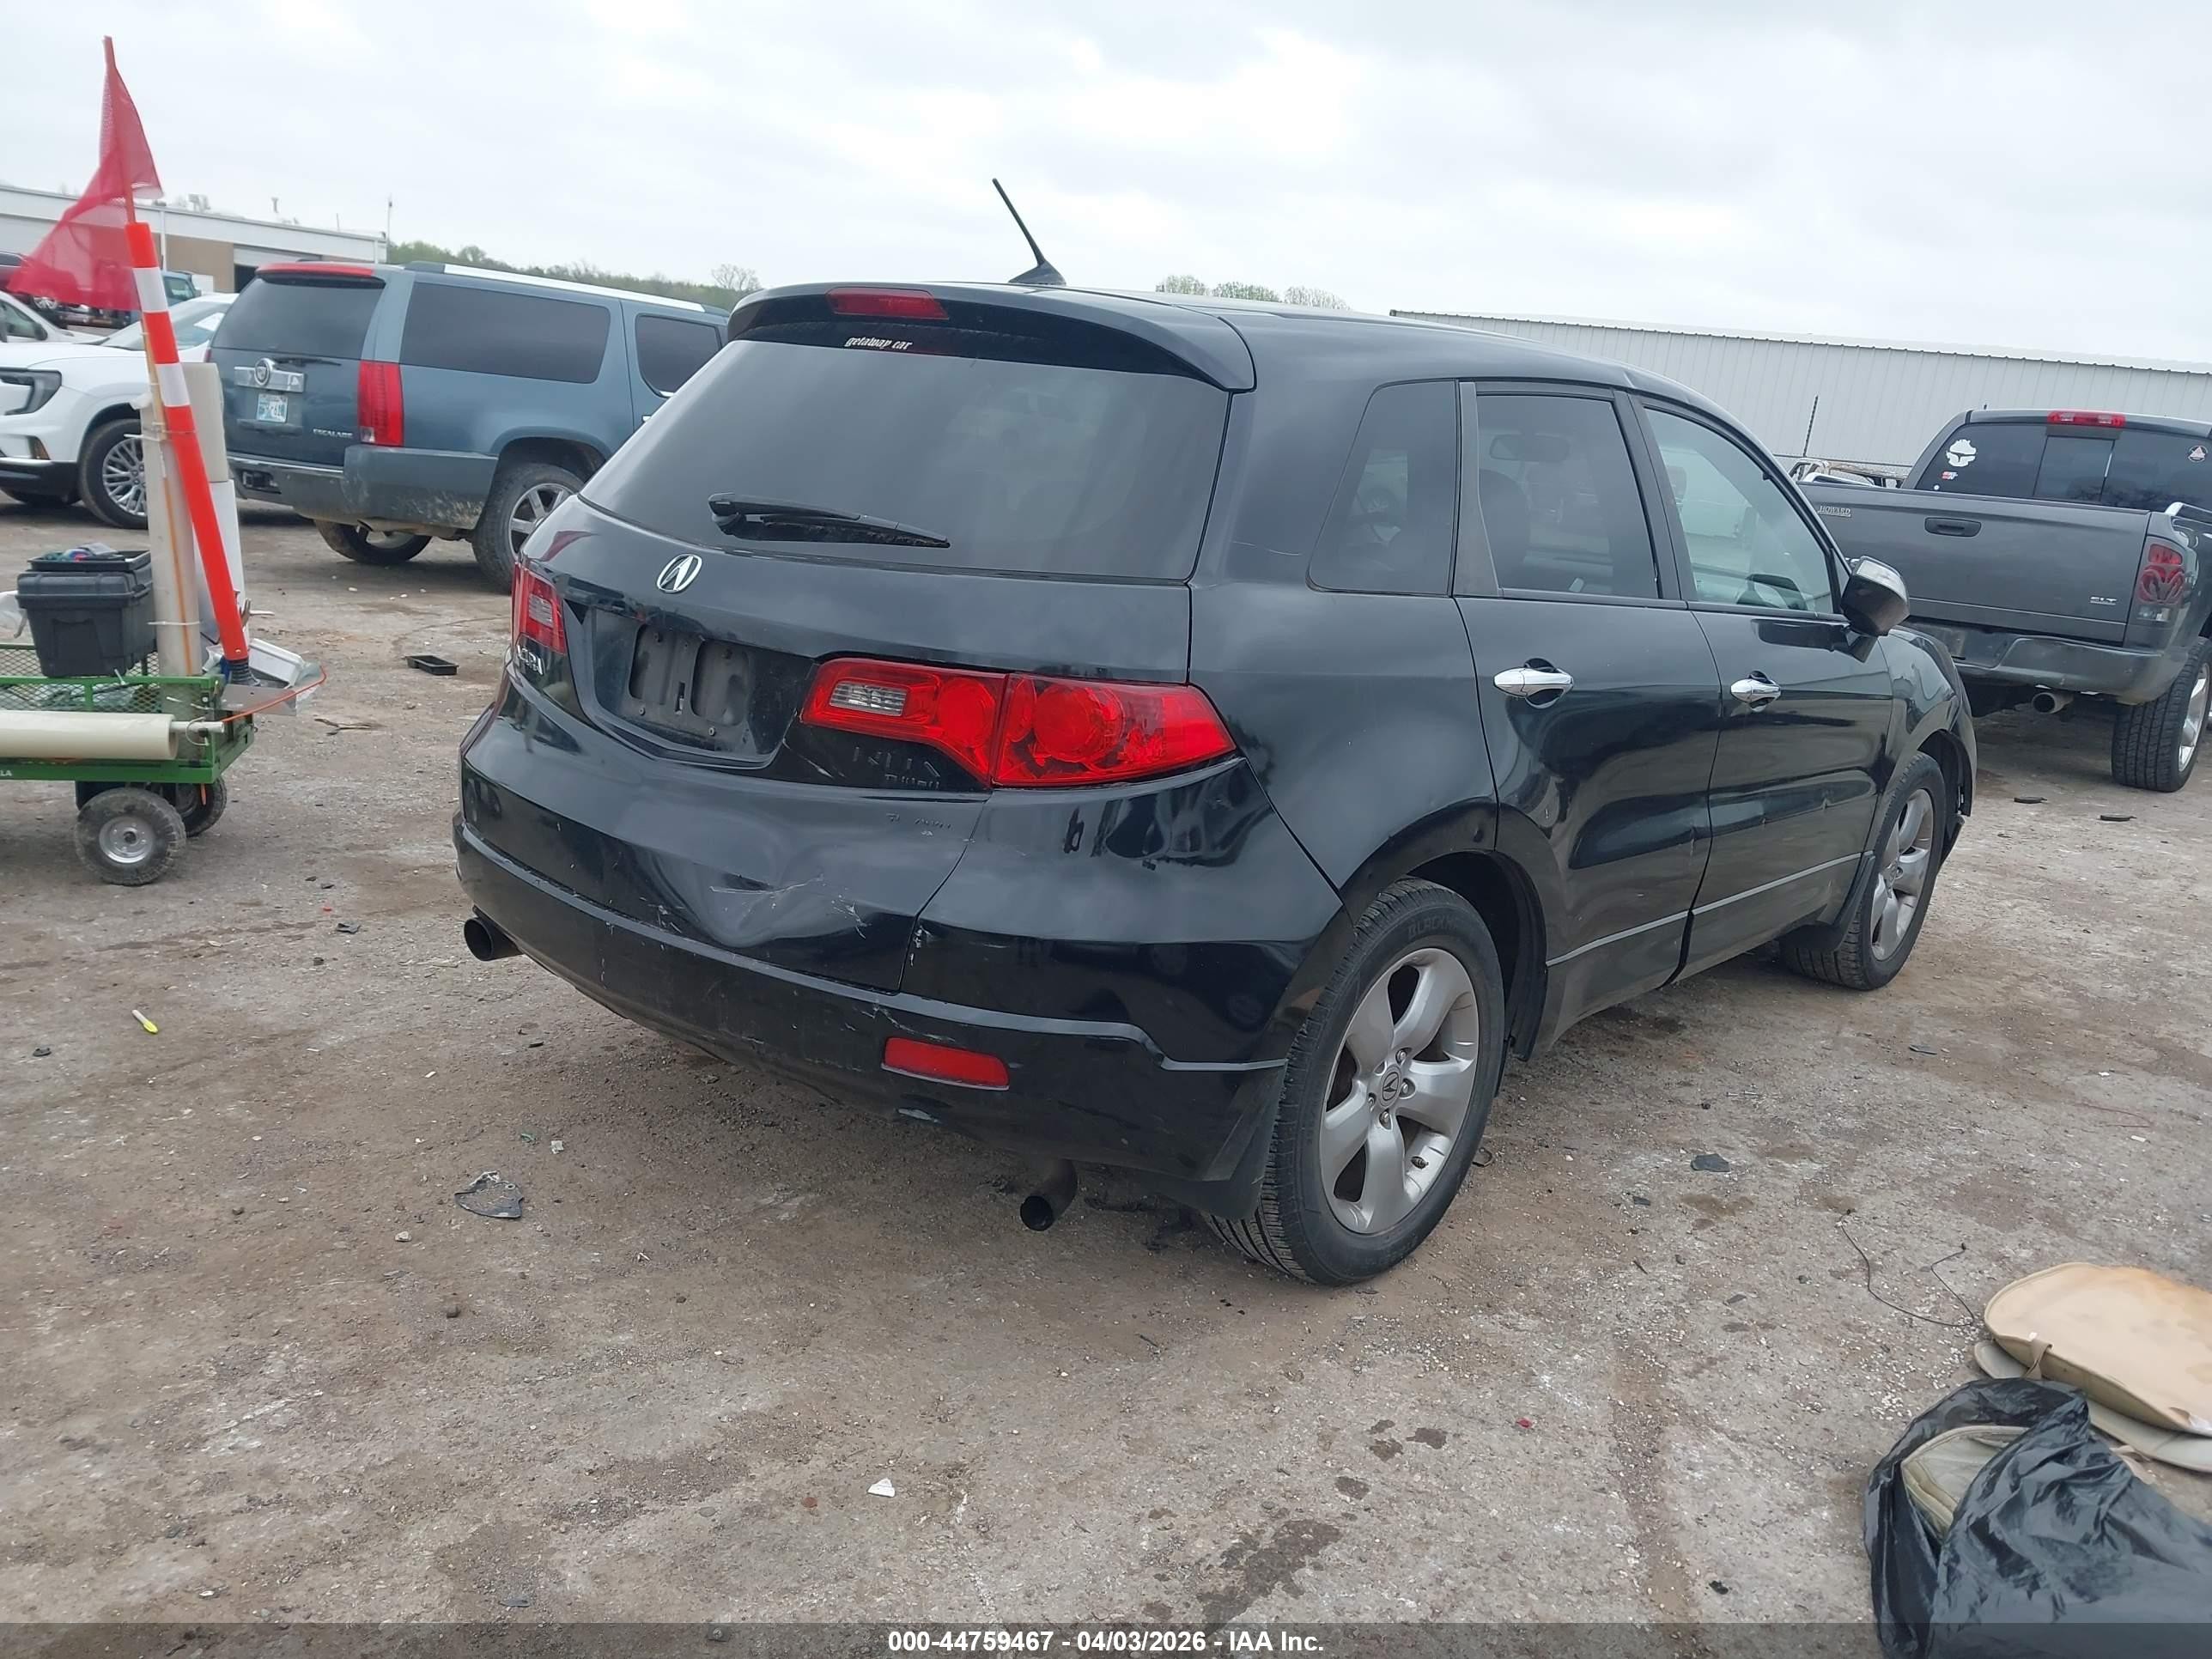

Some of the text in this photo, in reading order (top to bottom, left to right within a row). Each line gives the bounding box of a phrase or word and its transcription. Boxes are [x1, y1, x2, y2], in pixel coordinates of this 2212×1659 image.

[844, 337, 913, 349] getaway car
[1819, 505, 1851, 516] HOWARD
